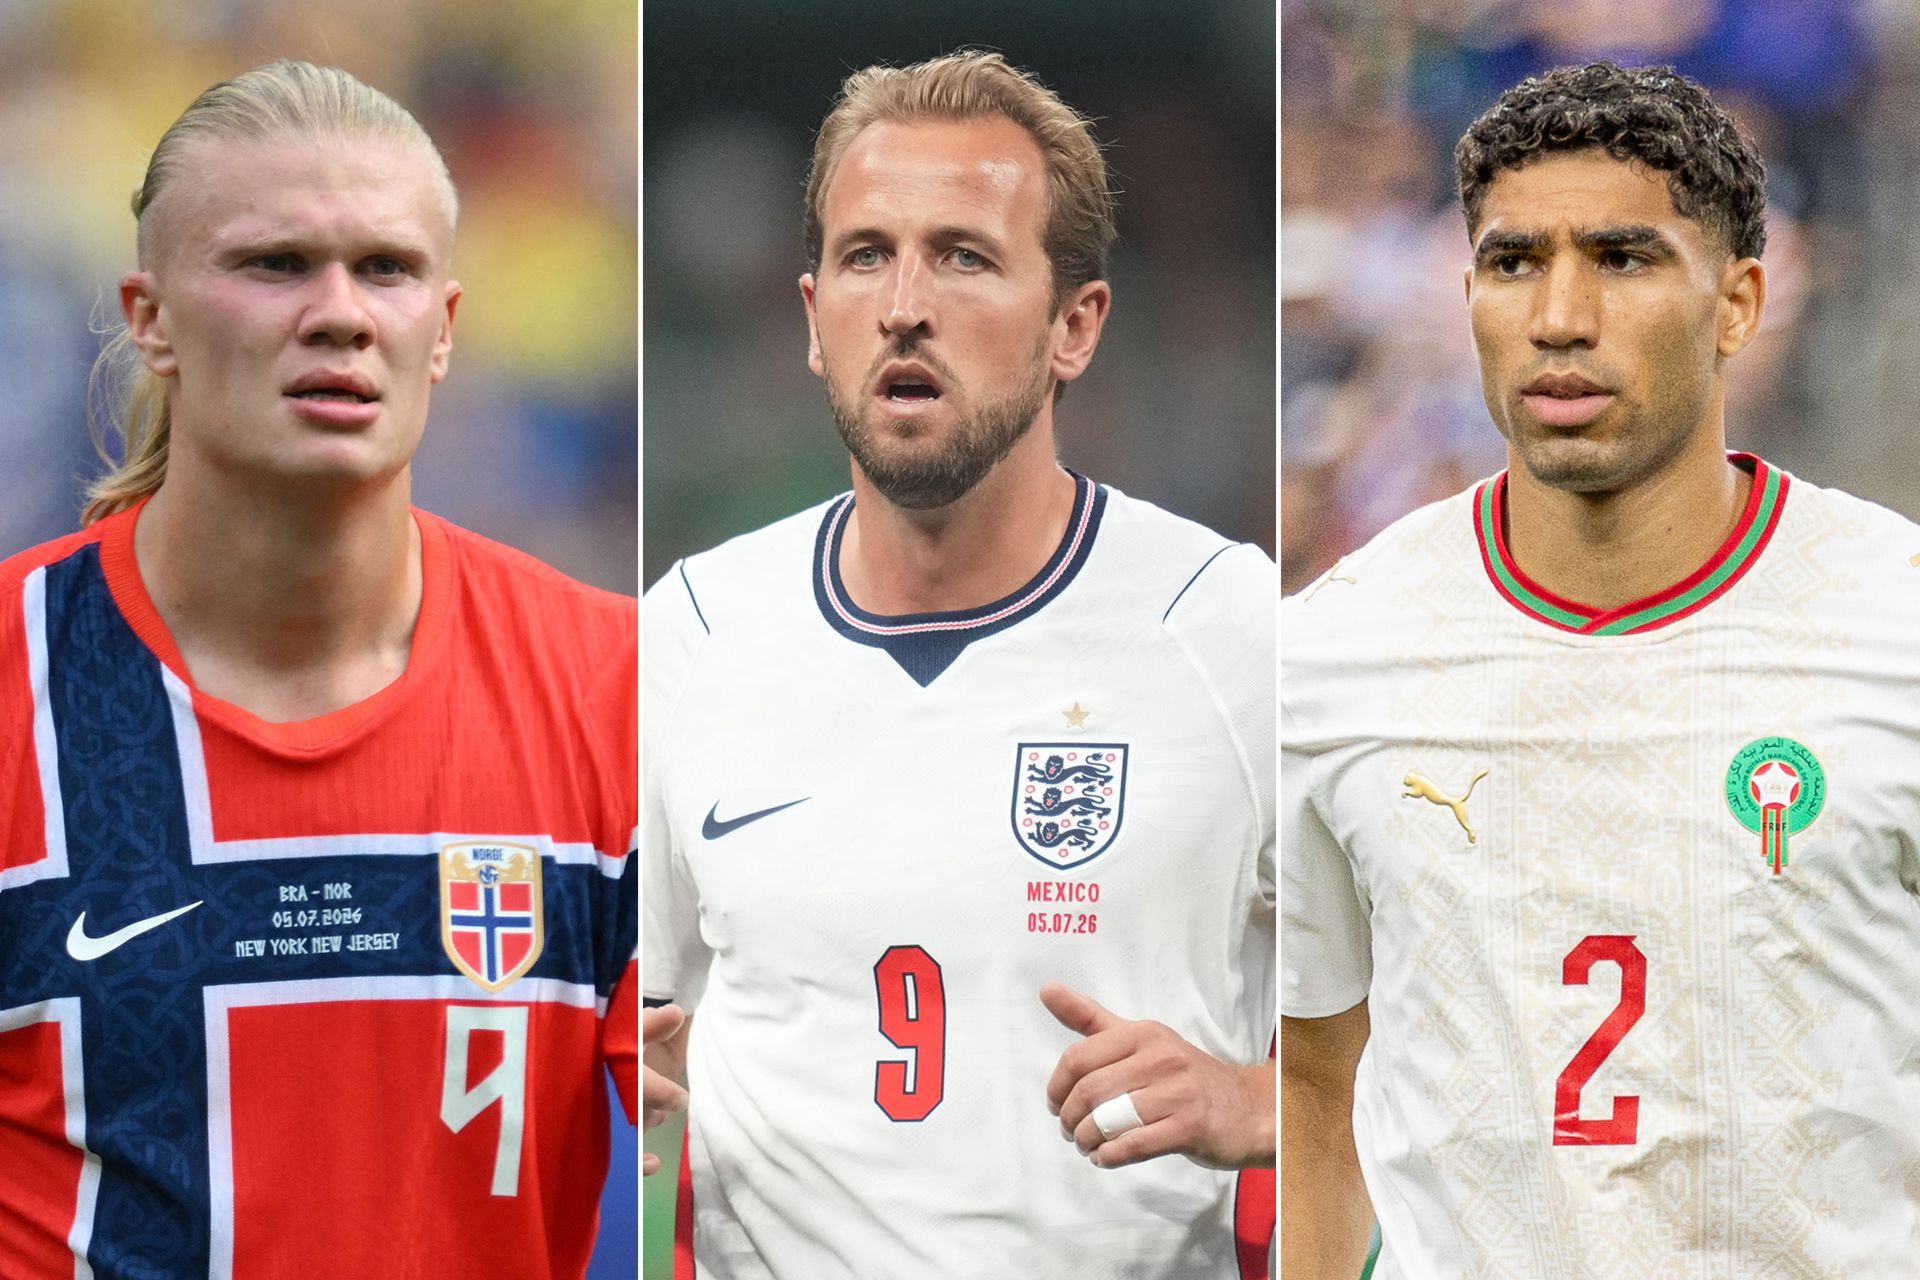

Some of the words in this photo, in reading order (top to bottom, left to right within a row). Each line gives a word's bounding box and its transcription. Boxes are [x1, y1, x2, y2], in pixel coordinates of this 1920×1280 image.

[472, 848, 504, 861] NORGE
[279, 885, 308, 903] BRA
[323, 882, 353, 901] NOR
[1026, 881, 1100, 903] MEXICO
[272, 907, 362, 928] 05.07.2026
[1027, 913, 1098, 934] 05.07.26
[235, 939, 266, 958] NEW
[270, 937, 308, 956] YORK
[311, 935, 343, 954] NEW
[346, 932, 400, 951] JERSEY
[873, 944, 947, 1123] 9
[1552, 934, 1648, 1146] 2
[439, 1005, 529, 1198] 9
